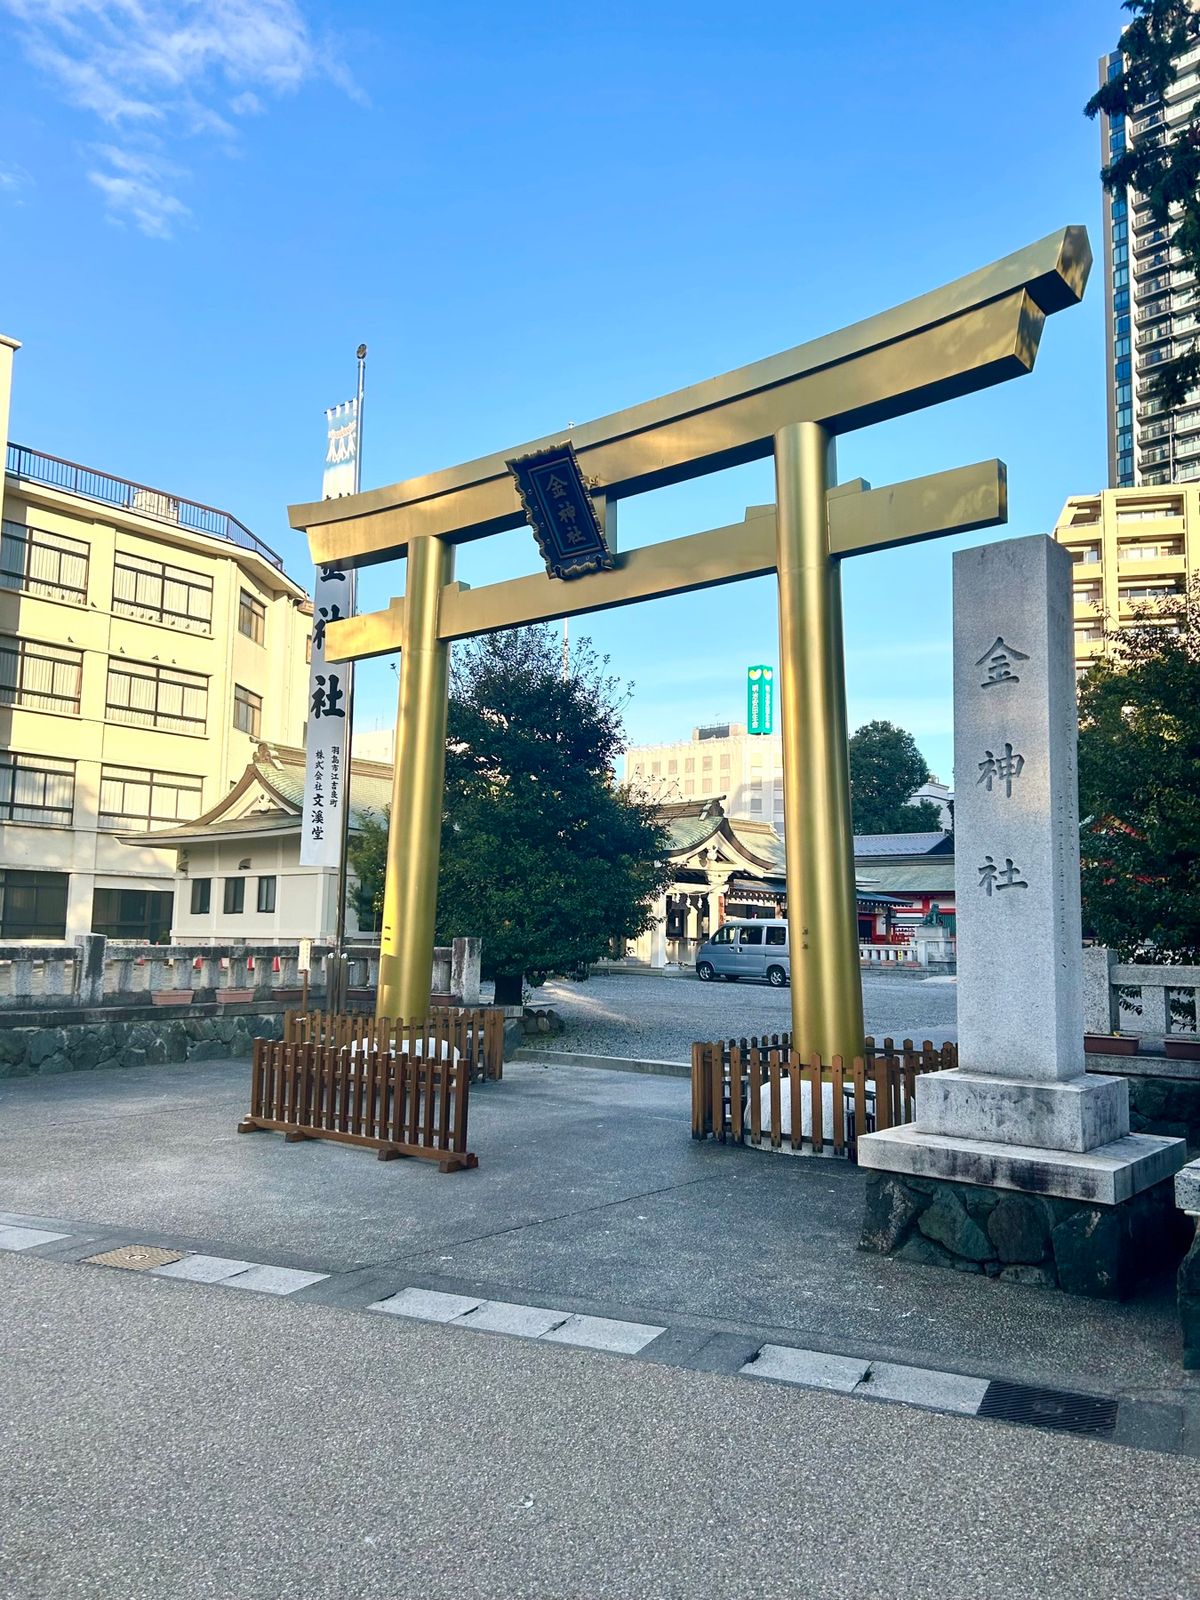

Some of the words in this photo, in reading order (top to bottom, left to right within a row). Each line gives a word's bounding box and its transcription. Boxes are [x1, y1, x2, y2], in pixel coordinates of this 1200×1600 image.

[546, 473, 586, 545] 金神社
[975, 637, 1030, 897] 金神社
